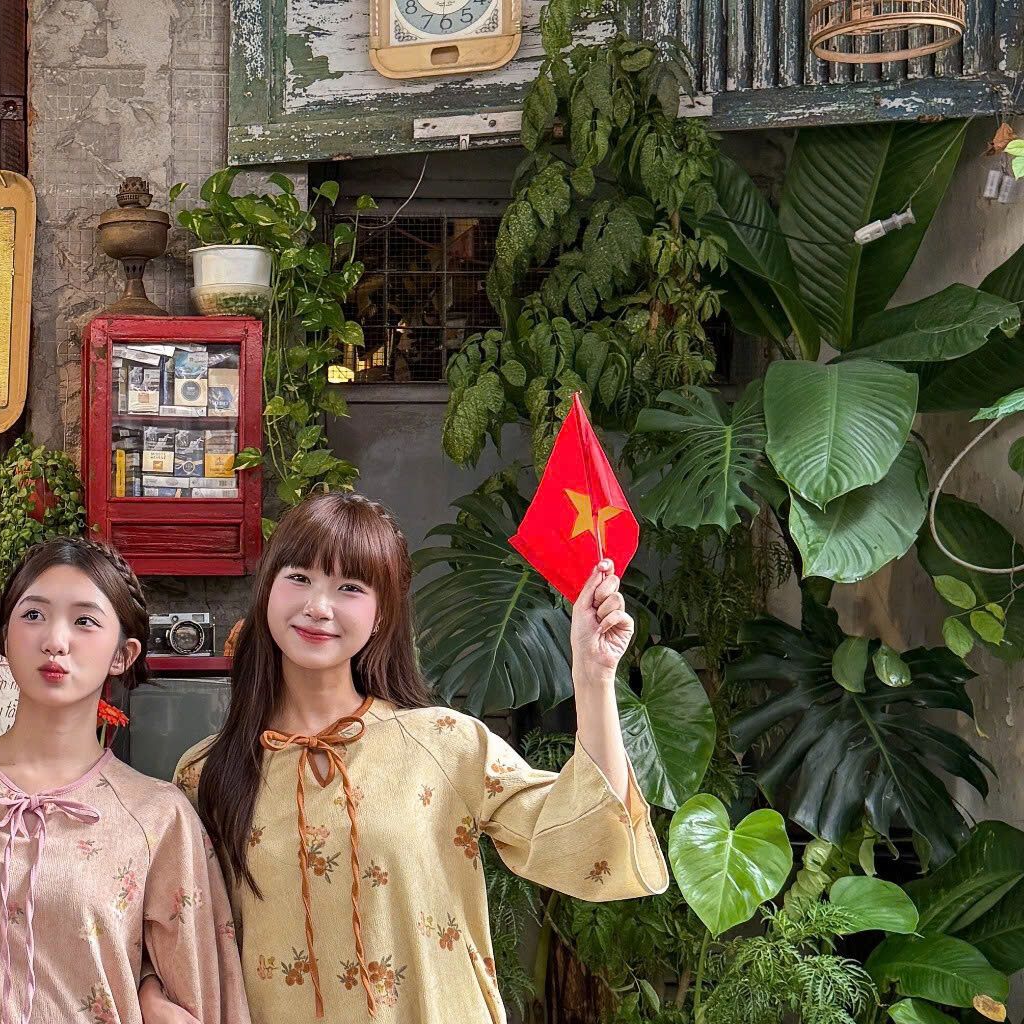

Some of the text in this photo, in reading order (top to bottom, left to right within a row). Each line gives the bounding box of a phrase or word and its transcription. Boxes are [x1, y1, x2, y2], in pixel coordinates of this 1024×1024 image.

[421, 14, 433, 30] 7
[439, 14, 452, 30] 6
[460, 8, 473, 23] 5
